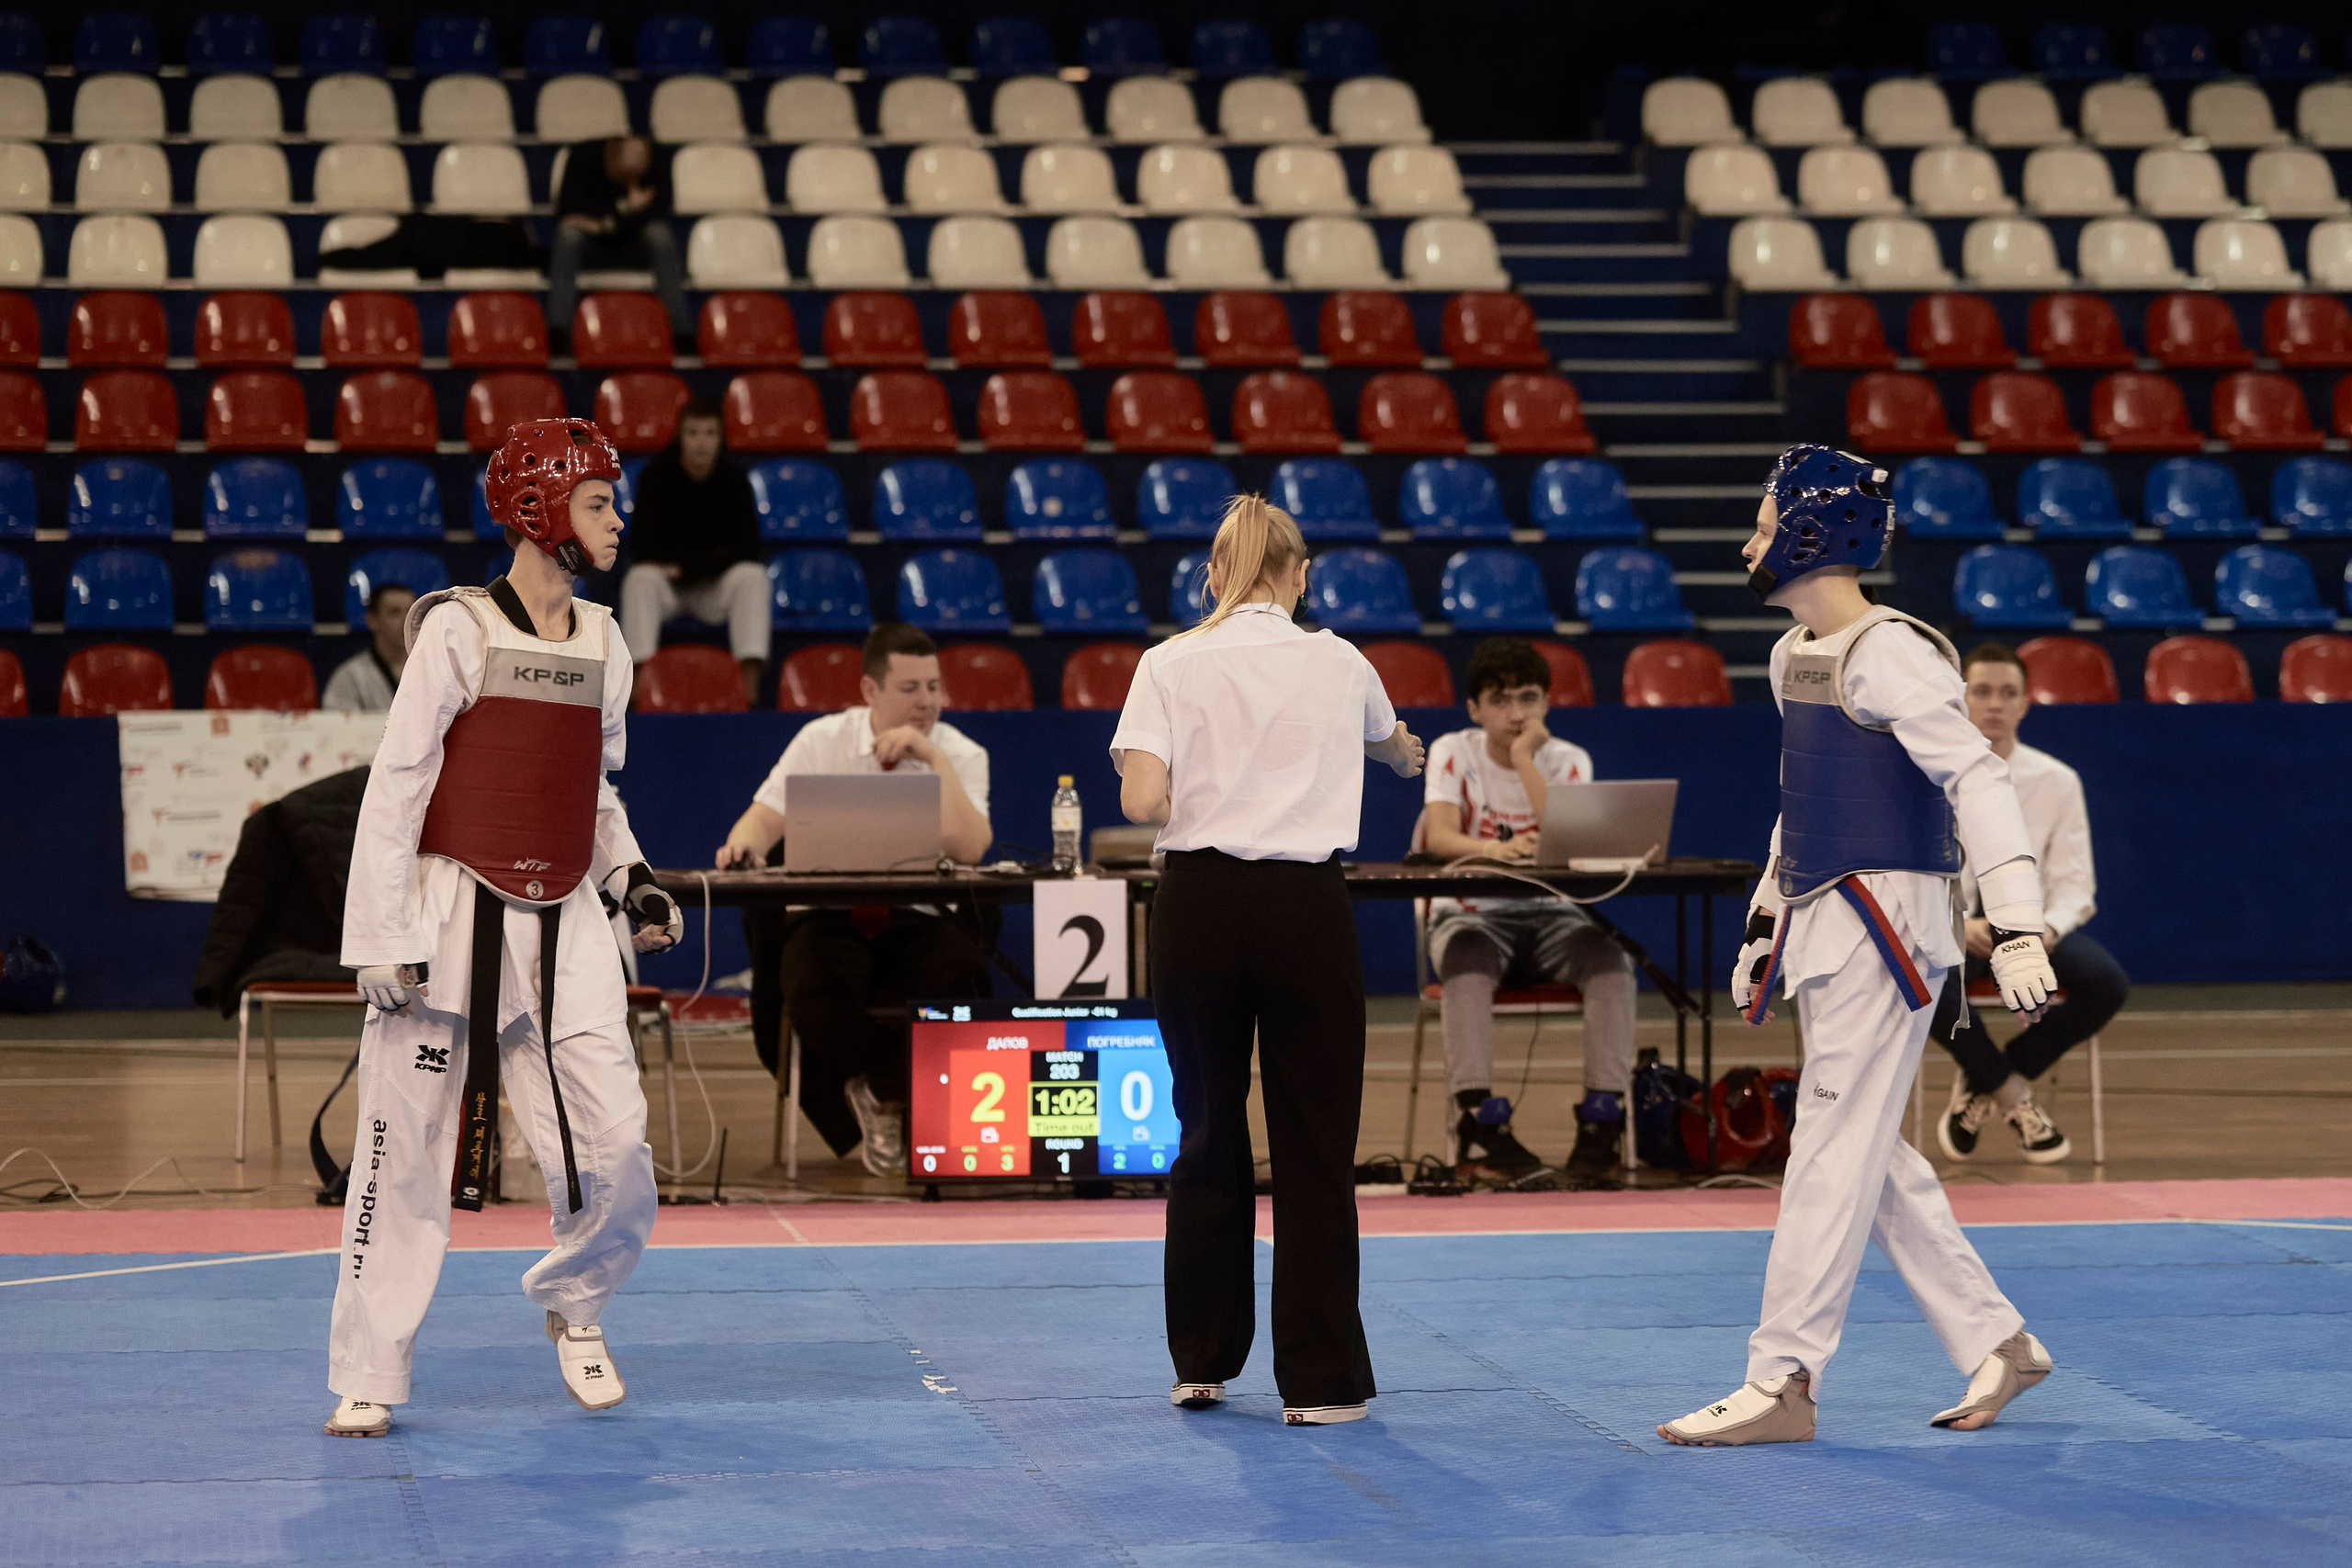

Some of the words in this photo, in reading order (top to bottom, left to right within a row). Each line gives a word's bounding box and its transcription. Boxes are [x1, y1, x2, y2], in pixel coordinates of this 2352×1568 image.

[514, 666, 584, 687] KP&P
[514, 857, 551, 872] WTF
[531, 883, 539, 897] 3
[2001, 940, 2030, 954] KHAN
[1058, 914, 1110, 998] 2
[1088, 1035, 1156, 1049] ПОГРЕБНЯК
[1046, 1051, 1084, 1063] MATCH
[414, 1062, 447, 1074] KPNP
[970, 1071, 1005, 1122] 2
[1035, 1089, 1096, 1116] 1:02
[1120, 1070, 1154, 1122] 0
[1035, 1122, 1069, 1134] Time
[1073, 1122, 1094, 1134] out
[1046, 1138, 1084, 1151] ROUND
[923, 1155, 936, 1172] 0
[964, 1154, 977, 1172] 0
[1001, 1154, 1014, 1171] 3
[1057, 1152, 1070, 1174] 1
[1113, 1152, 1126, 1170] 2
[1151, 1152, 1165, 1169] 0
